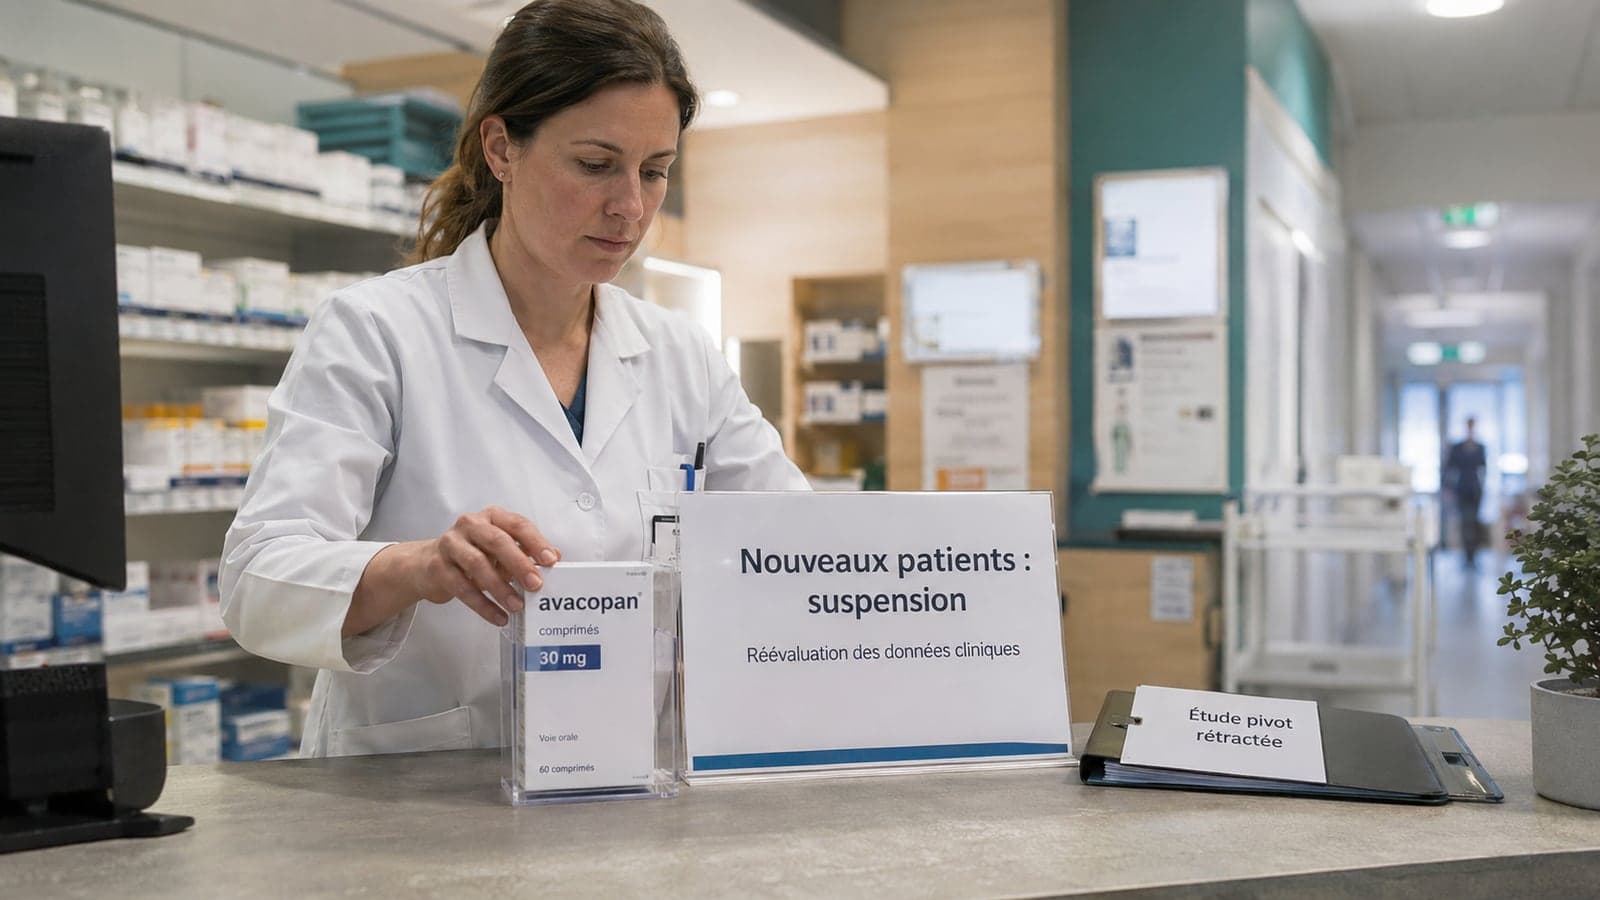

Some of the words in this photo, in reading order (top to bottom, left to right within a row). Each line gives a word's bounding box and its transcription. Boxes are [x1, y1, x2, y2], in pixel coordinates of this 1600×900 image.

[741, 548, 889, 574] Nouveaux
[897, 546, 1016, 579] patients
[1024, 553, 1032, 572] :
[808, 586, 967, 619] suspension
[539, 623, 600, 638] comprimés
[539, 651, 559, 665] 30
[562, 654, 587, 668] mg
[747, 645, 848, 663] Réévaluation
[853, 644, 880, 660] des
[885, 643, 951, 660] données
[954, 641, 1021, 661] cliniques
[1189, 706, 1241, 724] Étude
[1247, 714, 1293, 729] pivot
[539, 733, 557, 743] Voie
[558, 732, 578, 742] orale
[1197, 728, 1283, 748] rétractée
[539, 765, 550, 774] 60
[551, 763, 595, 775] comprimés
